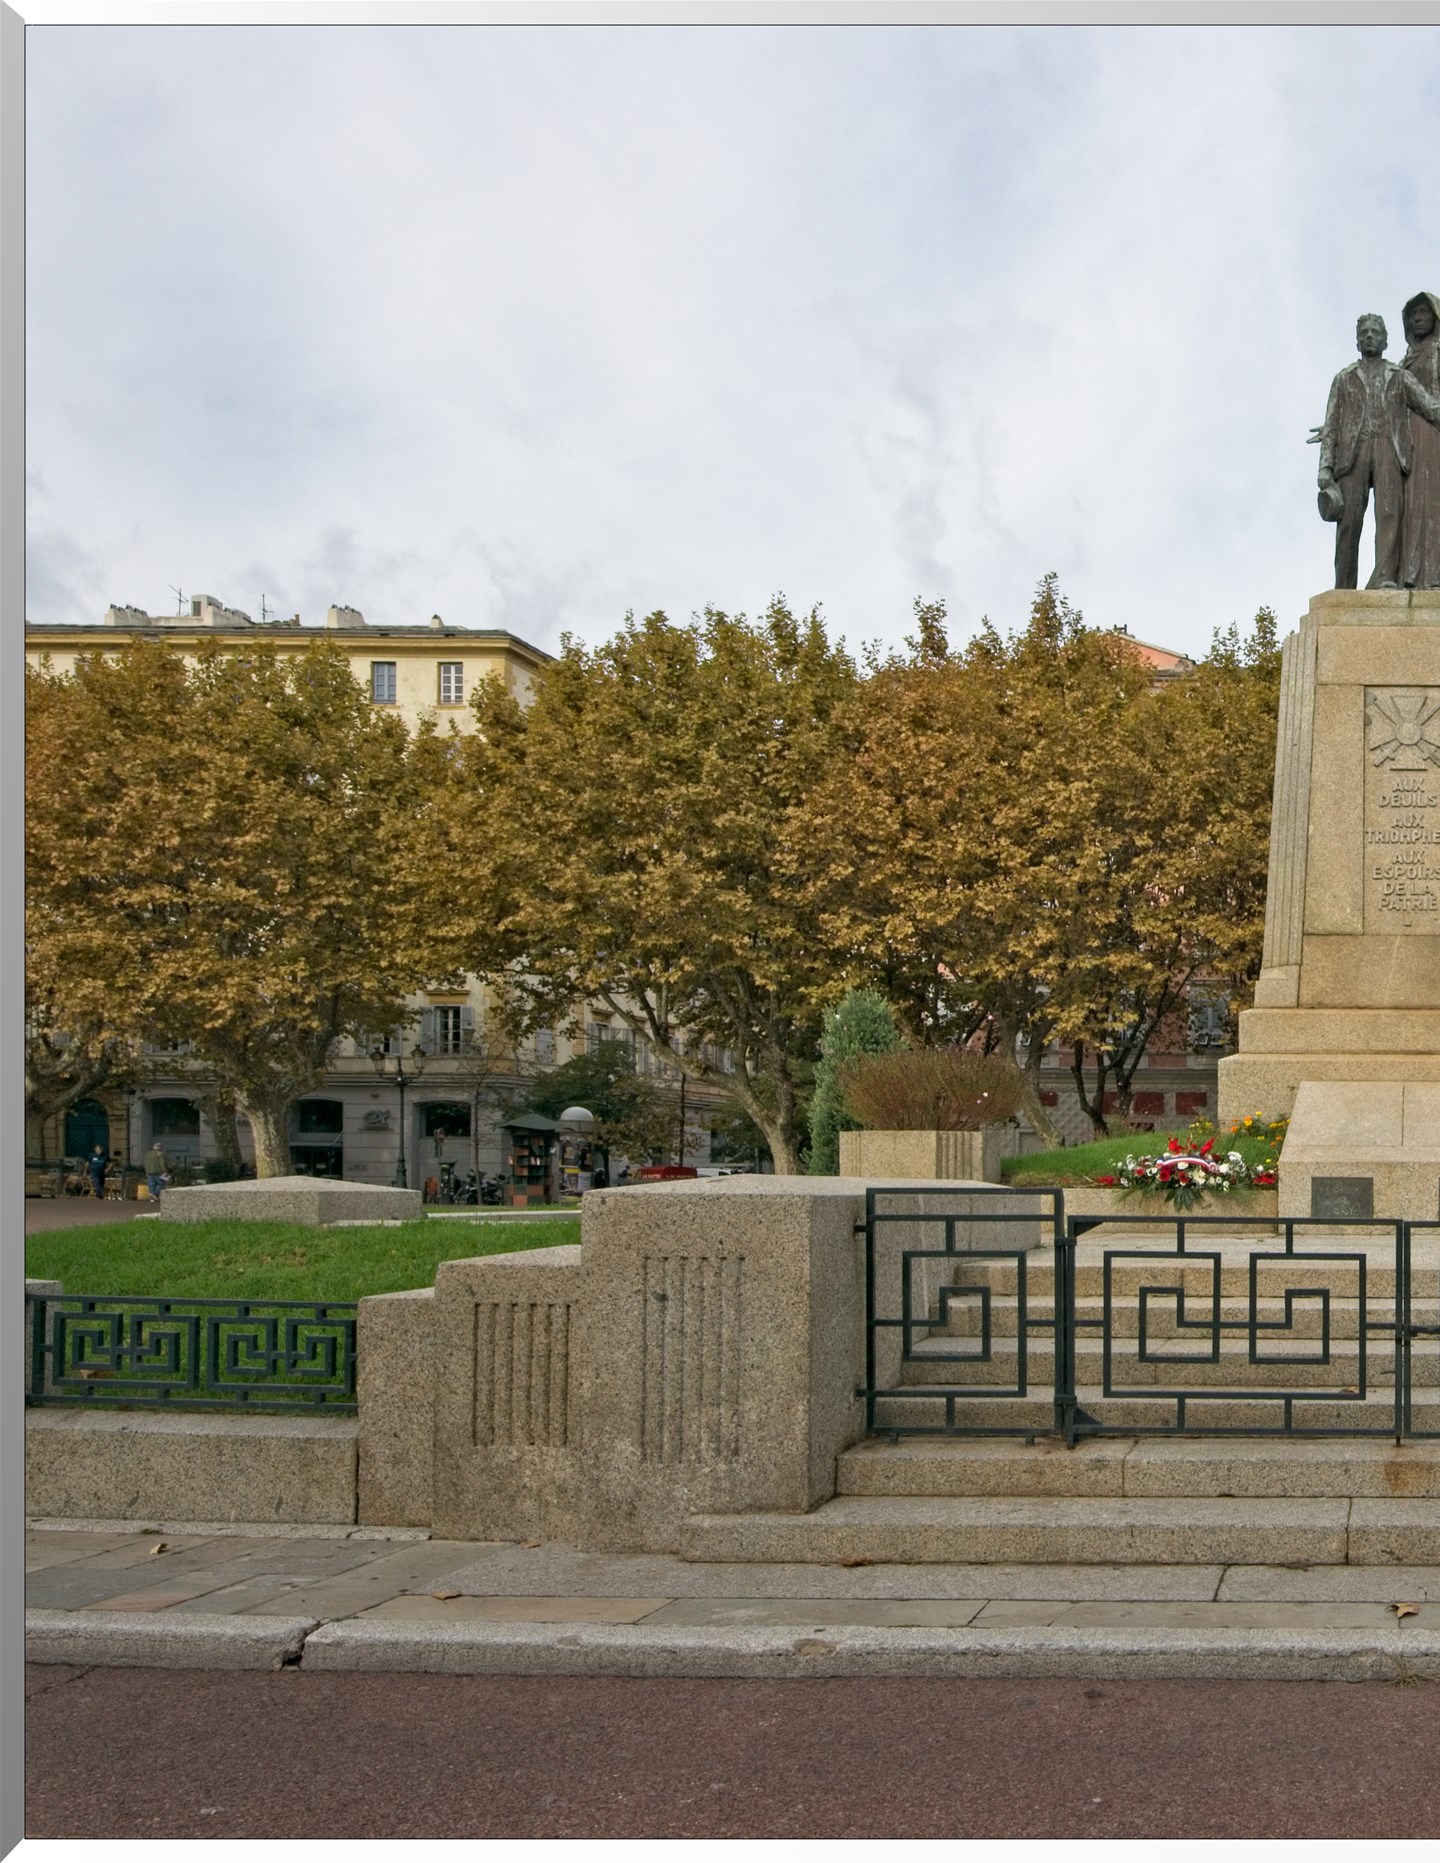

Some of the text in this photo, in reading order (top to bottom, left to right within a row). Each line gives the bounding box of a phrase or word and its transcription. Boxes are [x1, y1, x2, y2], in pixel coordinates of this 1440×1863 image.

[1392, 778, 1425, 793] AUX
[1379, 793, 1437, 808] DEUILS
[1391, 814, 1425, 829] AUX
[1392, 850, 1425, 865] AUX
[1383, 881, 1434, 896] DE LA
[1378, 897, 1438, 912] PATRIE
